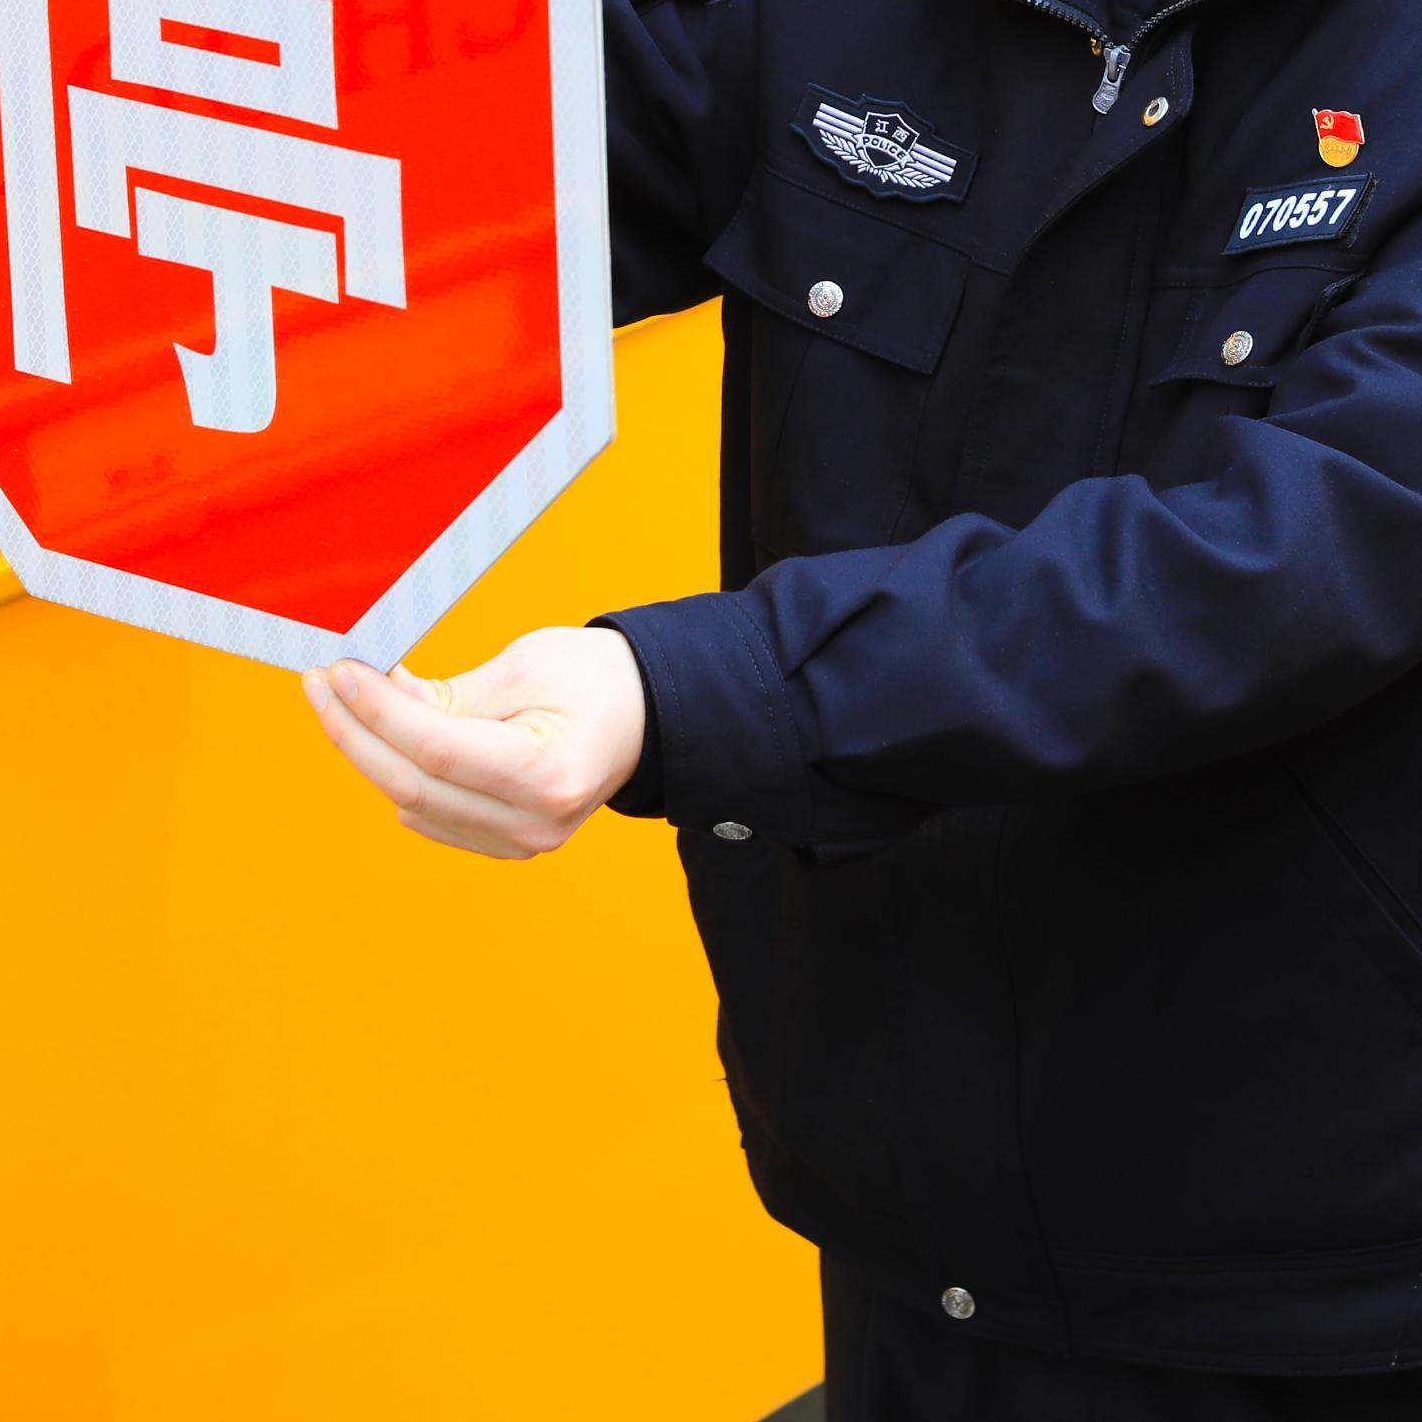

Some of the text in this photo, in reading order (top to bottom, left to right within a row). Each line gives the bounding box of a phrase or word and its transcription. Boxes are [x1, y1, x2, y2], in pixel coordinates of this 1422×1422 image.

[875, 119, 910, 143] 江西
[862, 135, 906, 159] POLICE
[1239, 189, 1357, 240] 070557
